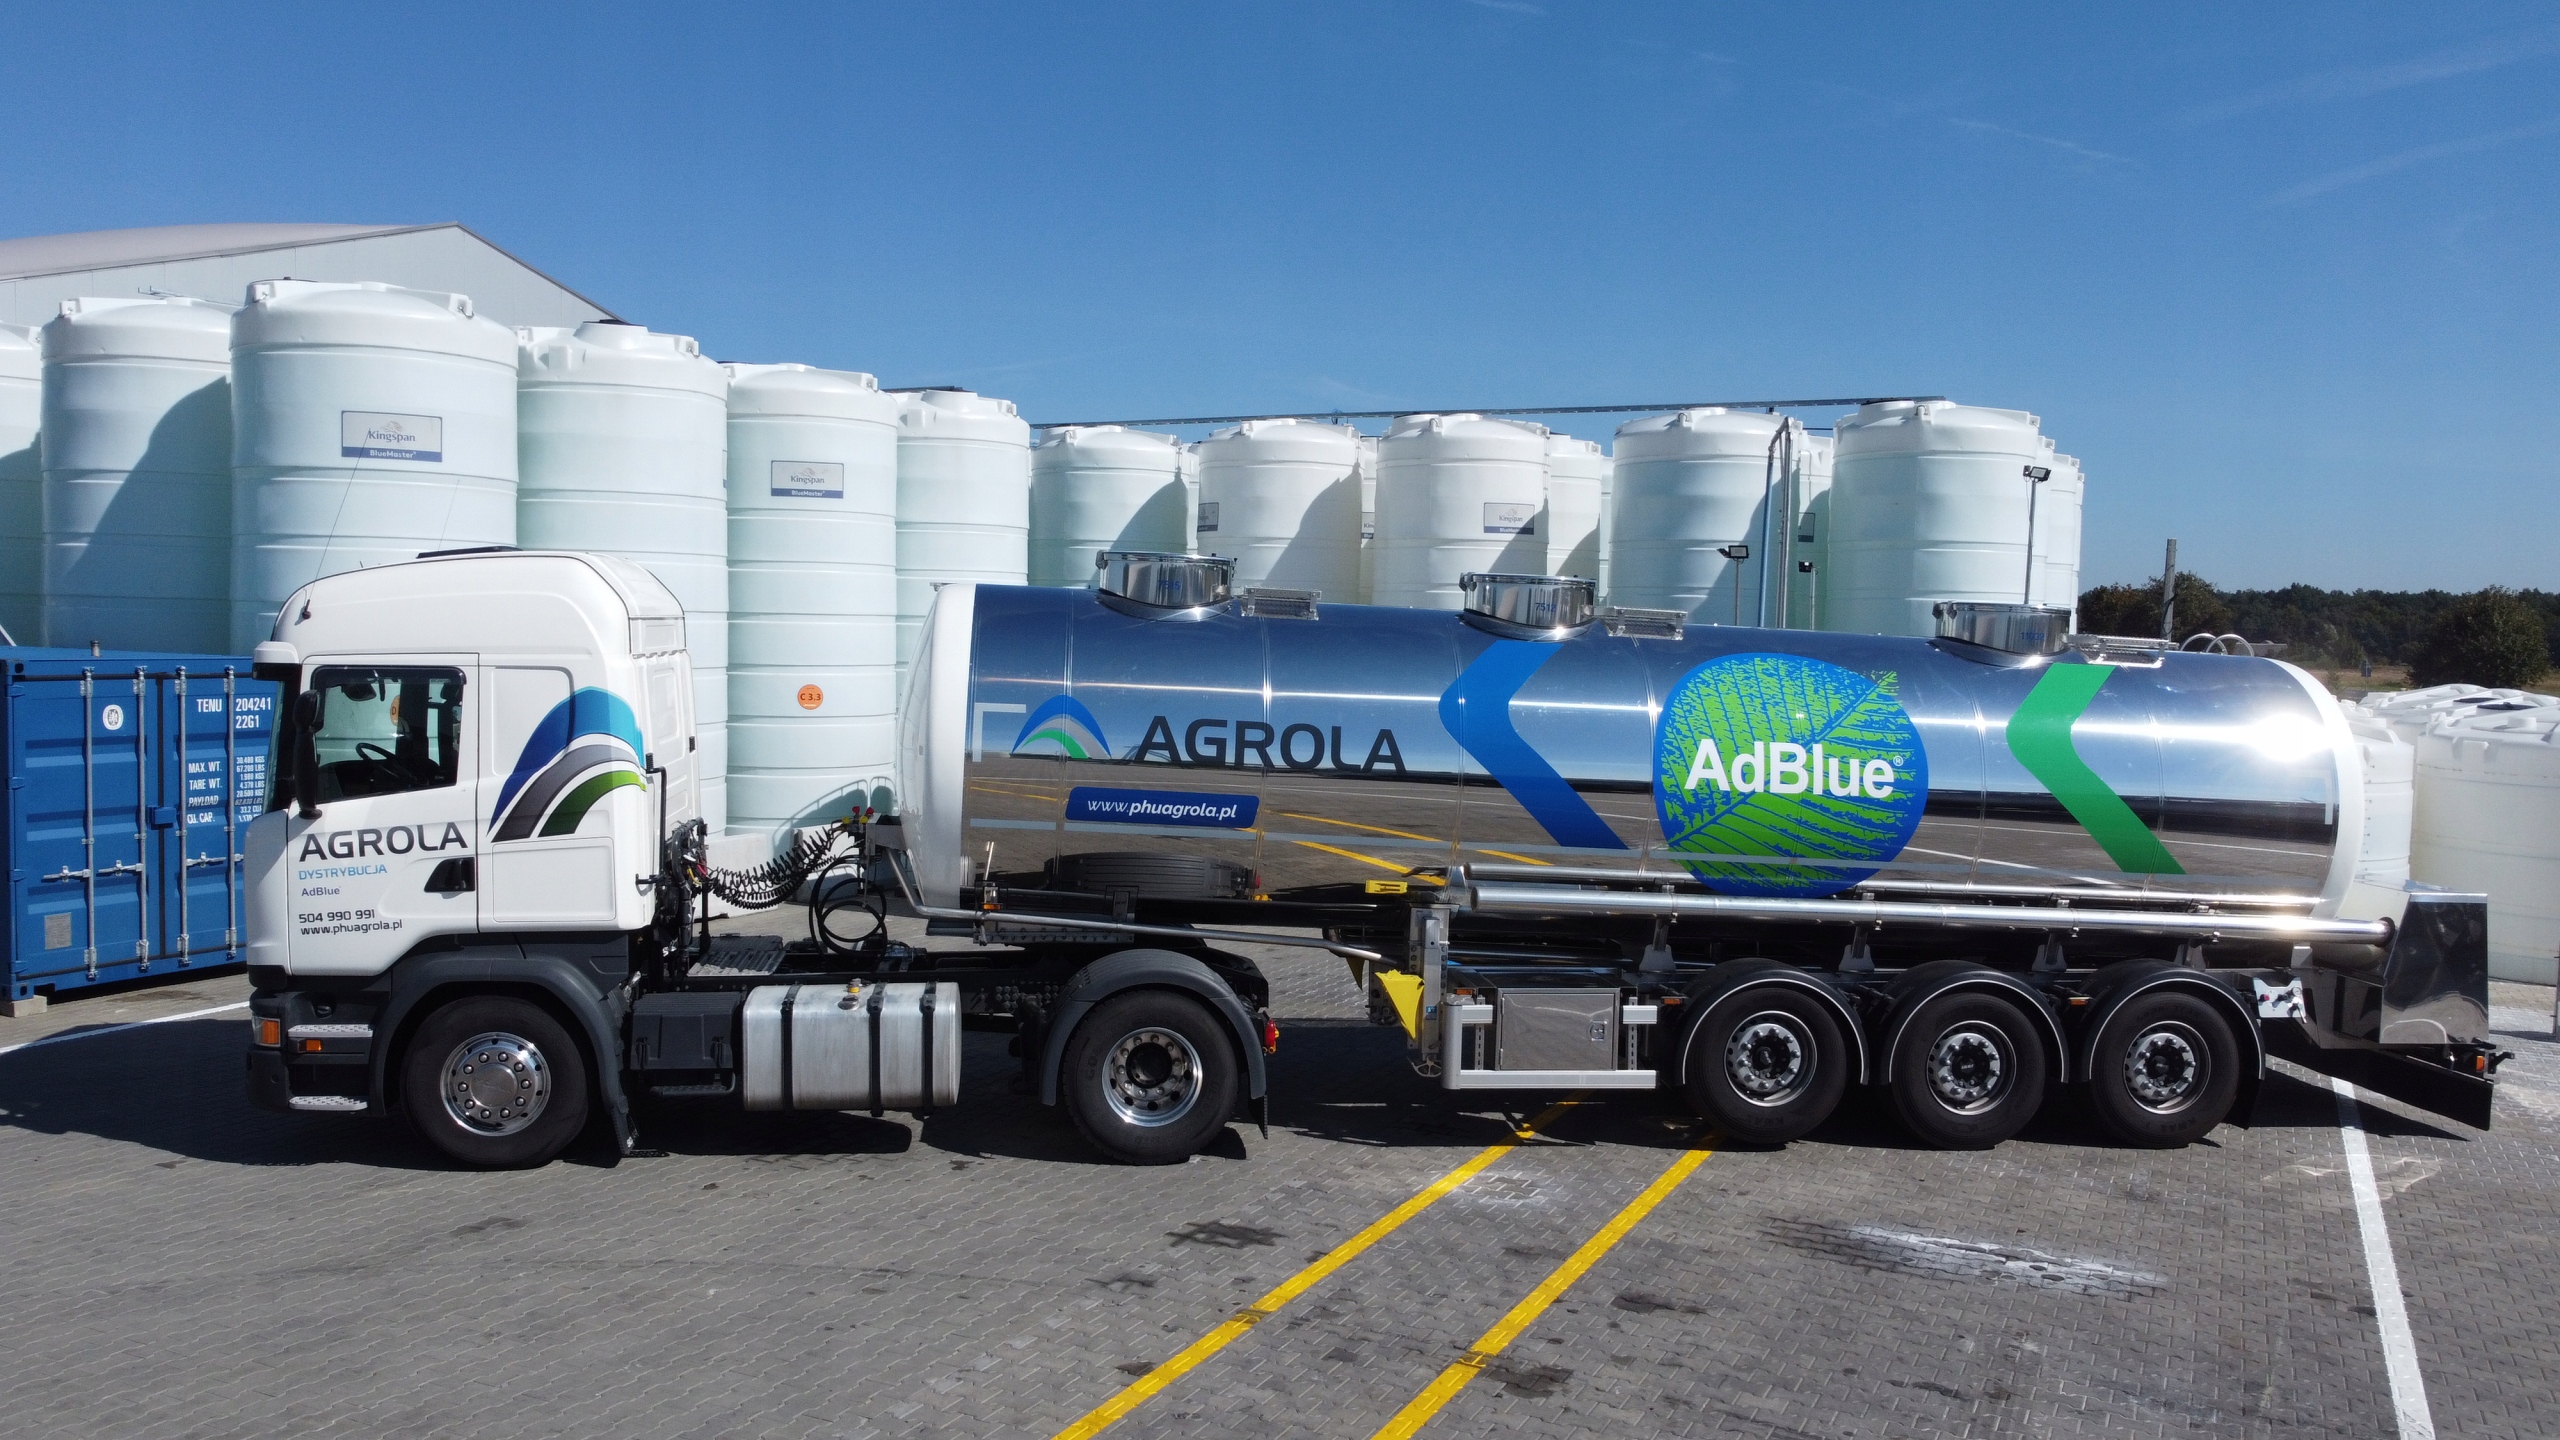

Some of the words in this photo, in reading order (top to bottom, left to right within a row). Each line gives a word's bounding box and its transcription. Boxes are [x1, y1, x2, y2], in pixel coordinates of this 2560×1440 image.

[369, 430, 415, 443] Kingspan
[791, 475, 824, 484] Kingspan
[800, 693, 806, 701] C
[196, 698, 223, 713] TENU
[235, 697, 271, 712] 204241
[235, 715, 259, 729] 22G1
[1134, 715, 1407, 774] AGROLA
[208, 761, 222, 772] WT.
[254, 764, 265, 772] LBS
[189, 779, 206, 791] TARE
[208, 778, 223, 789] WT.
[254, 780, 265, 788] LBS
[187, 795, 219, 807] PAYLOAD
[1087, 799, 1238, 821] www.phuagrola.pl
[199, 812, 216, 823] CAP.
[298, 821, 469, 863] AGROLA
[298, 864, 388, 880] DYSTRYBUCJA
[298, 912, 324, 923] 504
[327, 911, 352, 921] 990
[355, 909, 375, 919] 991
[300, 919, 403, 936] www.phuagrola.pl
